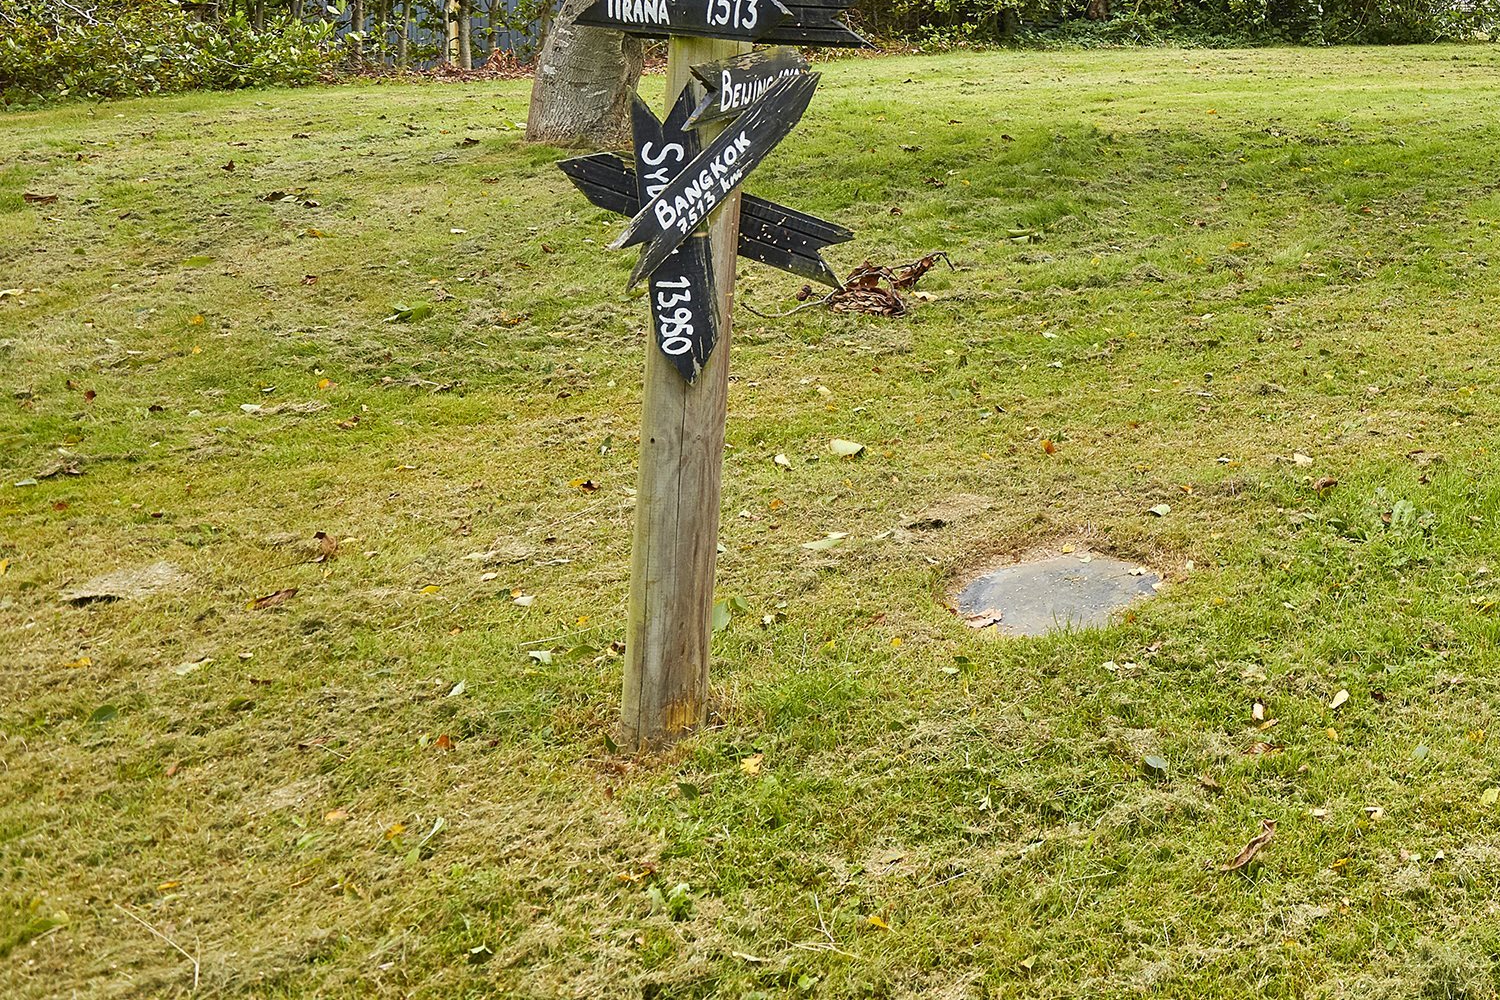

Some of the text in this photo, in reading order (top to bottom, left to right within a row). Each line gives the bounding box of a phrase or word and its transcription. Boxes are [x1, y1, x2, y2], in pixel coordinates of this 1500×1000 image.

[654, 130, 752, 230] BANGKOK
[676, 168, 743, 234] 7.513 km
[655, 275, 694, 355] 13.950
